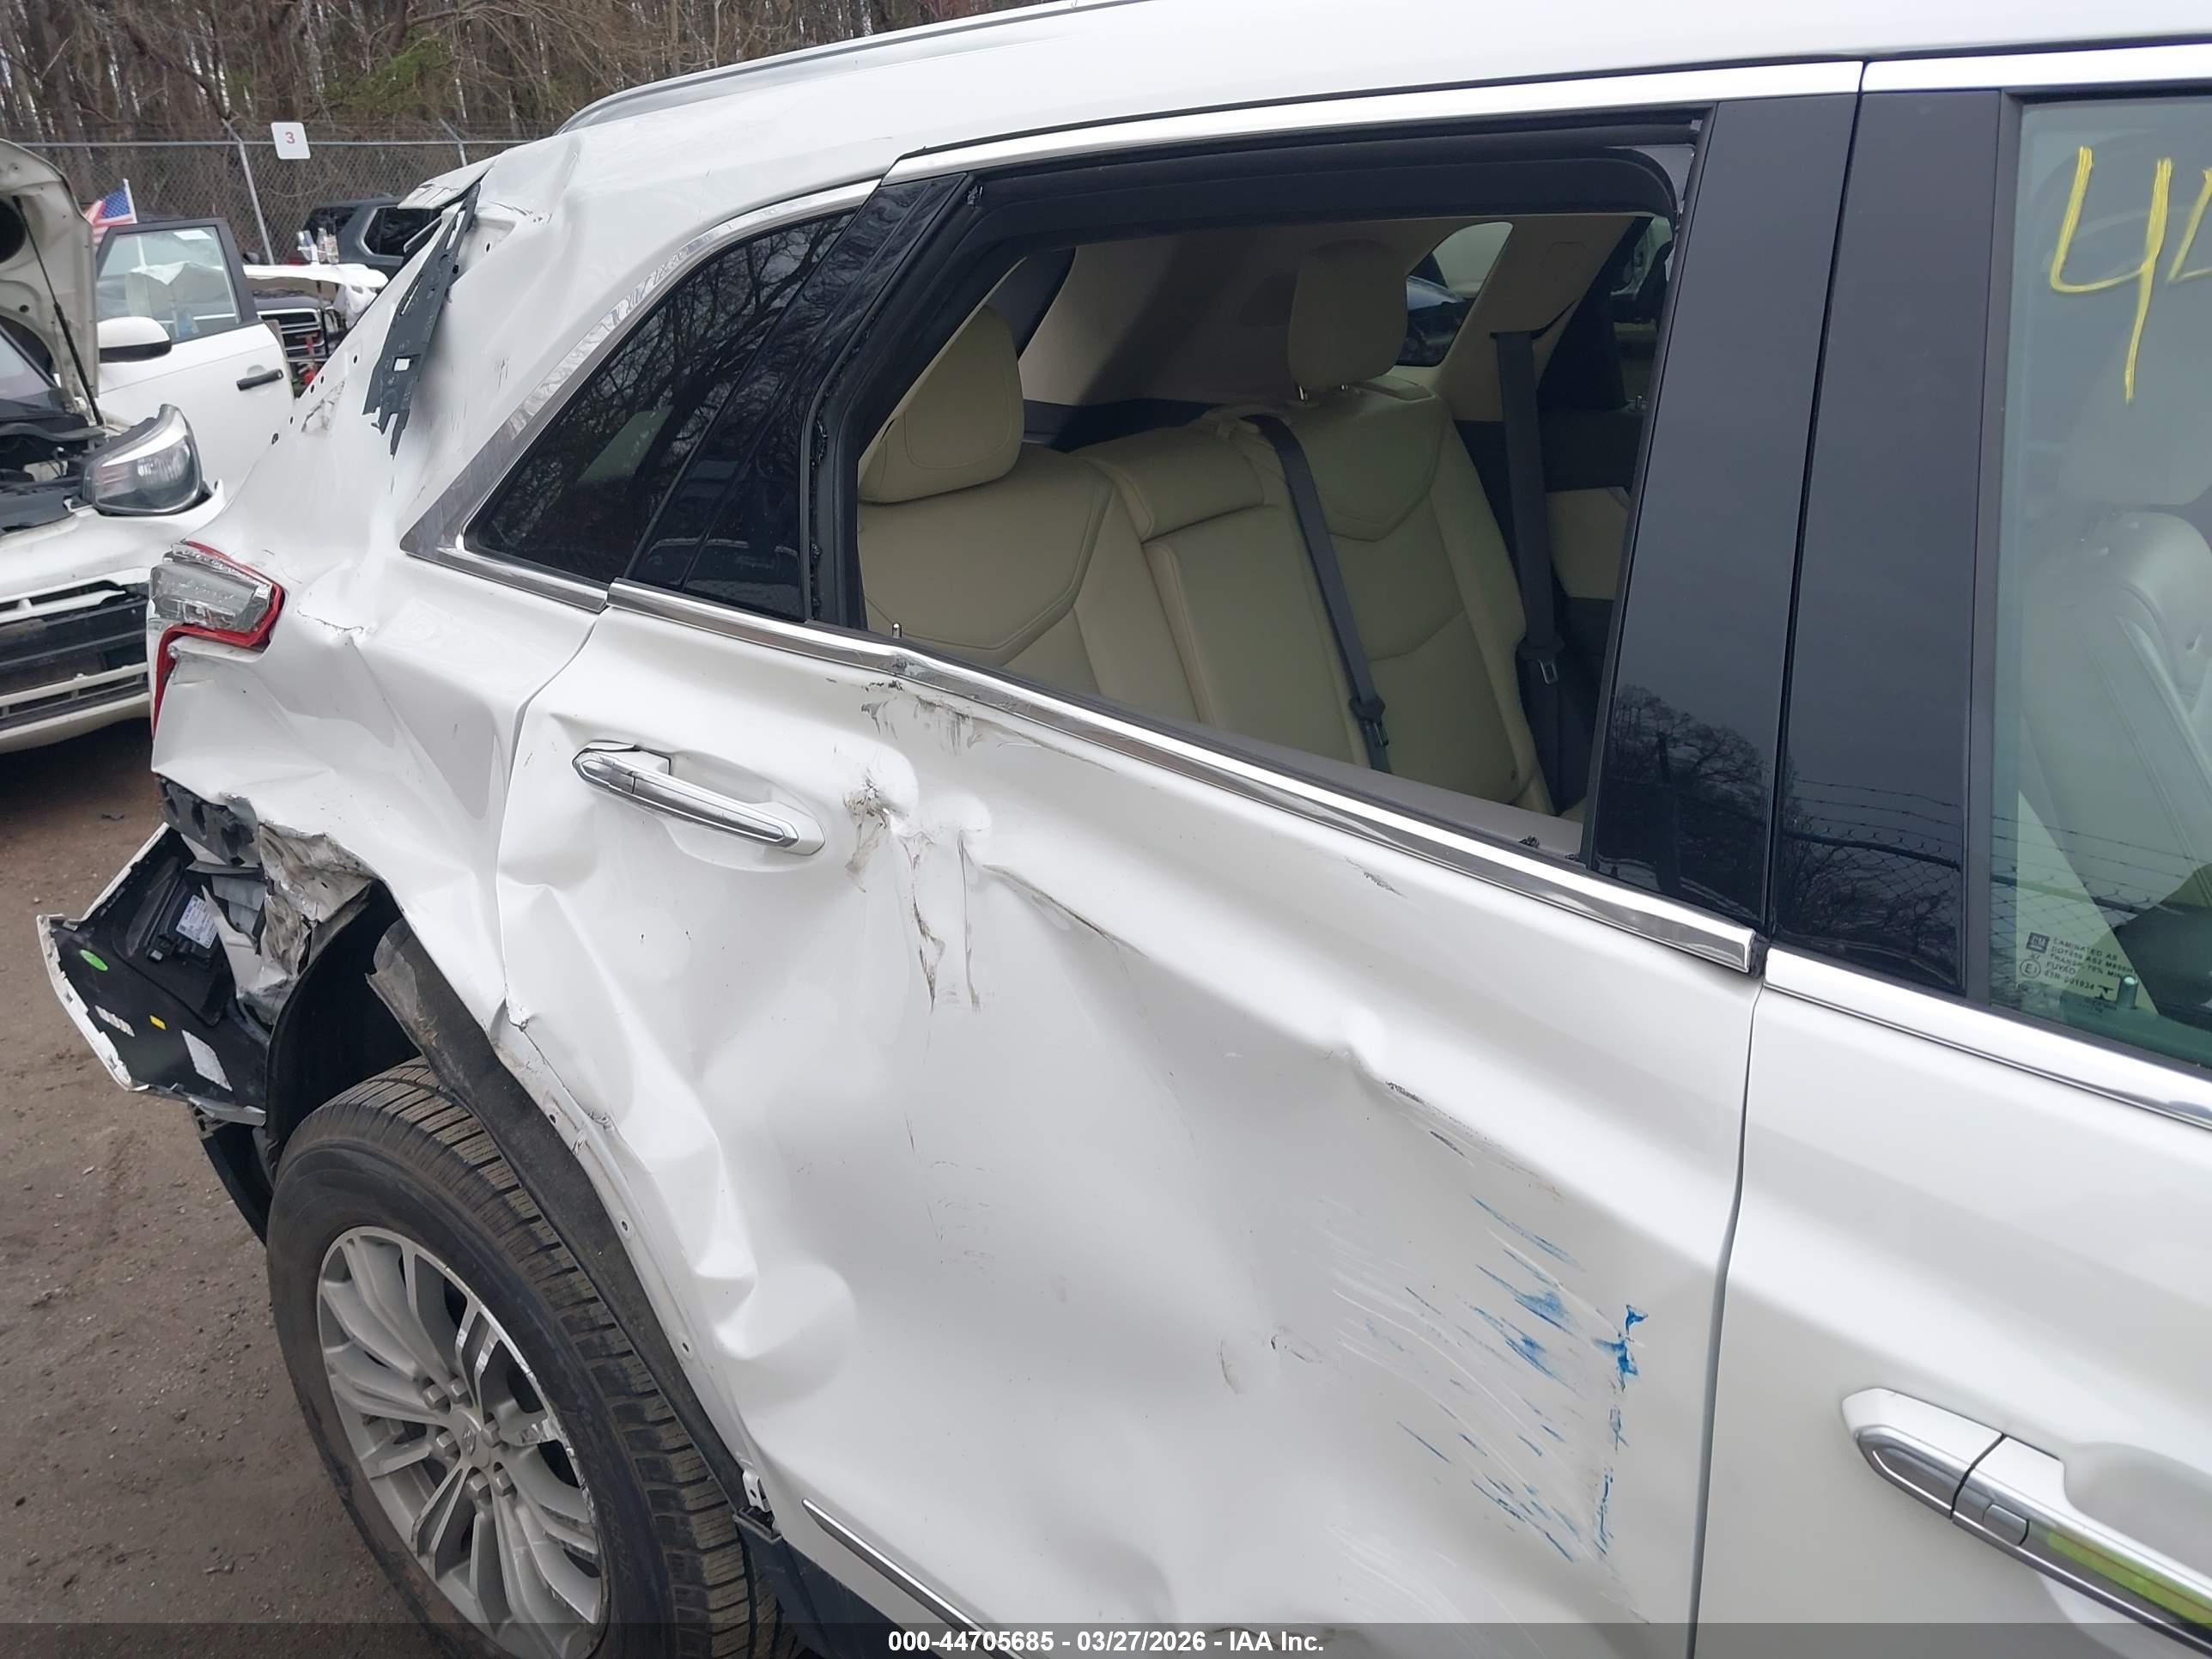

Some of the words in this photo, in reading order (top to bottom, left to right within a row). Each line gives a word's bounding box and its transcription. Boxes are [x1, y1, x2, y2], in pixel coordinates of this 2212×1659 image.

[285, 131, 295, 144] 3
[2053, 937, 2103, 956] LAMINATED
[2046, 961, 2075, 975] FUYAO
